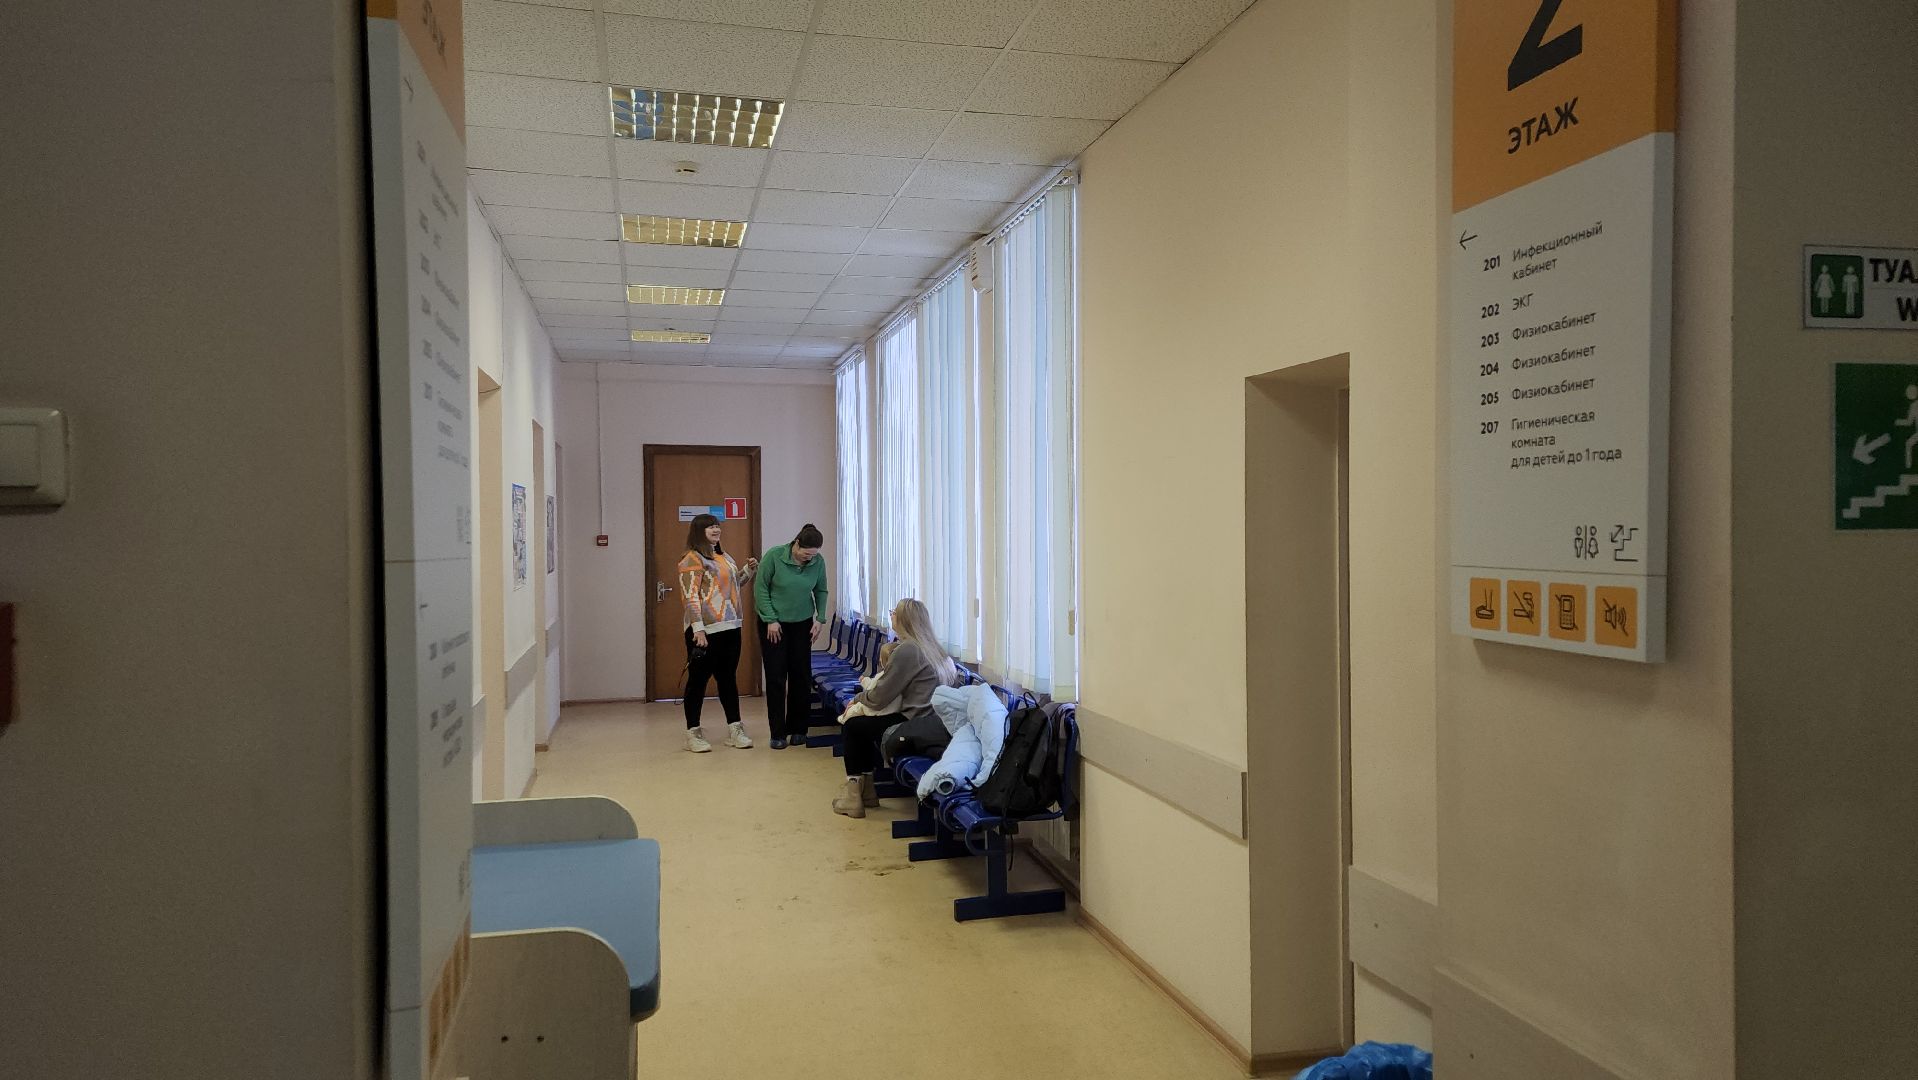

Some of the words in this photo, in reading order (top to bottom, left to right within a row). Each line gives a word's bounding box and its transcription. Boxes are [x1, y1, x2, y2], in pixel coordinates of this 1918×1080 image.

[1507, 97, 1579, 154] ЭТАЖ
[1484, 255, 1501, 271] 201
[1512, 221, 1603, 262] Инфекционный
[1512, 258, 1558, 280] кабинет
[1869, 258, 1918, 284] ТУА
[1481, 304, 1500, 318] 202
[1512, 293, 1534, 311] ЭКГ
[1481, 333, 1500, 347] 203
[1512, 312, 1597, 340] Физиокабинет
[1480, 362, 1499, 376] 204
[1512, 345, 1596, 370] Физиокабинет
[1481, 392, 1499, 405] 205
[1512, 378, 1595, 400] Физиокабинет
[1481, 422, 1499, 434] 207
[1511, 411, 1596, 430] Гигиеническая
[1511, 436, 1556, 448] комната
[1511, 456, 1531, 469] для
[1532, 449, 1566, 467] детей
[1567, 452, 1583, 465] до
[1585, 447, 1590, 461] 1
[1592, 448, 1622, 462] года
